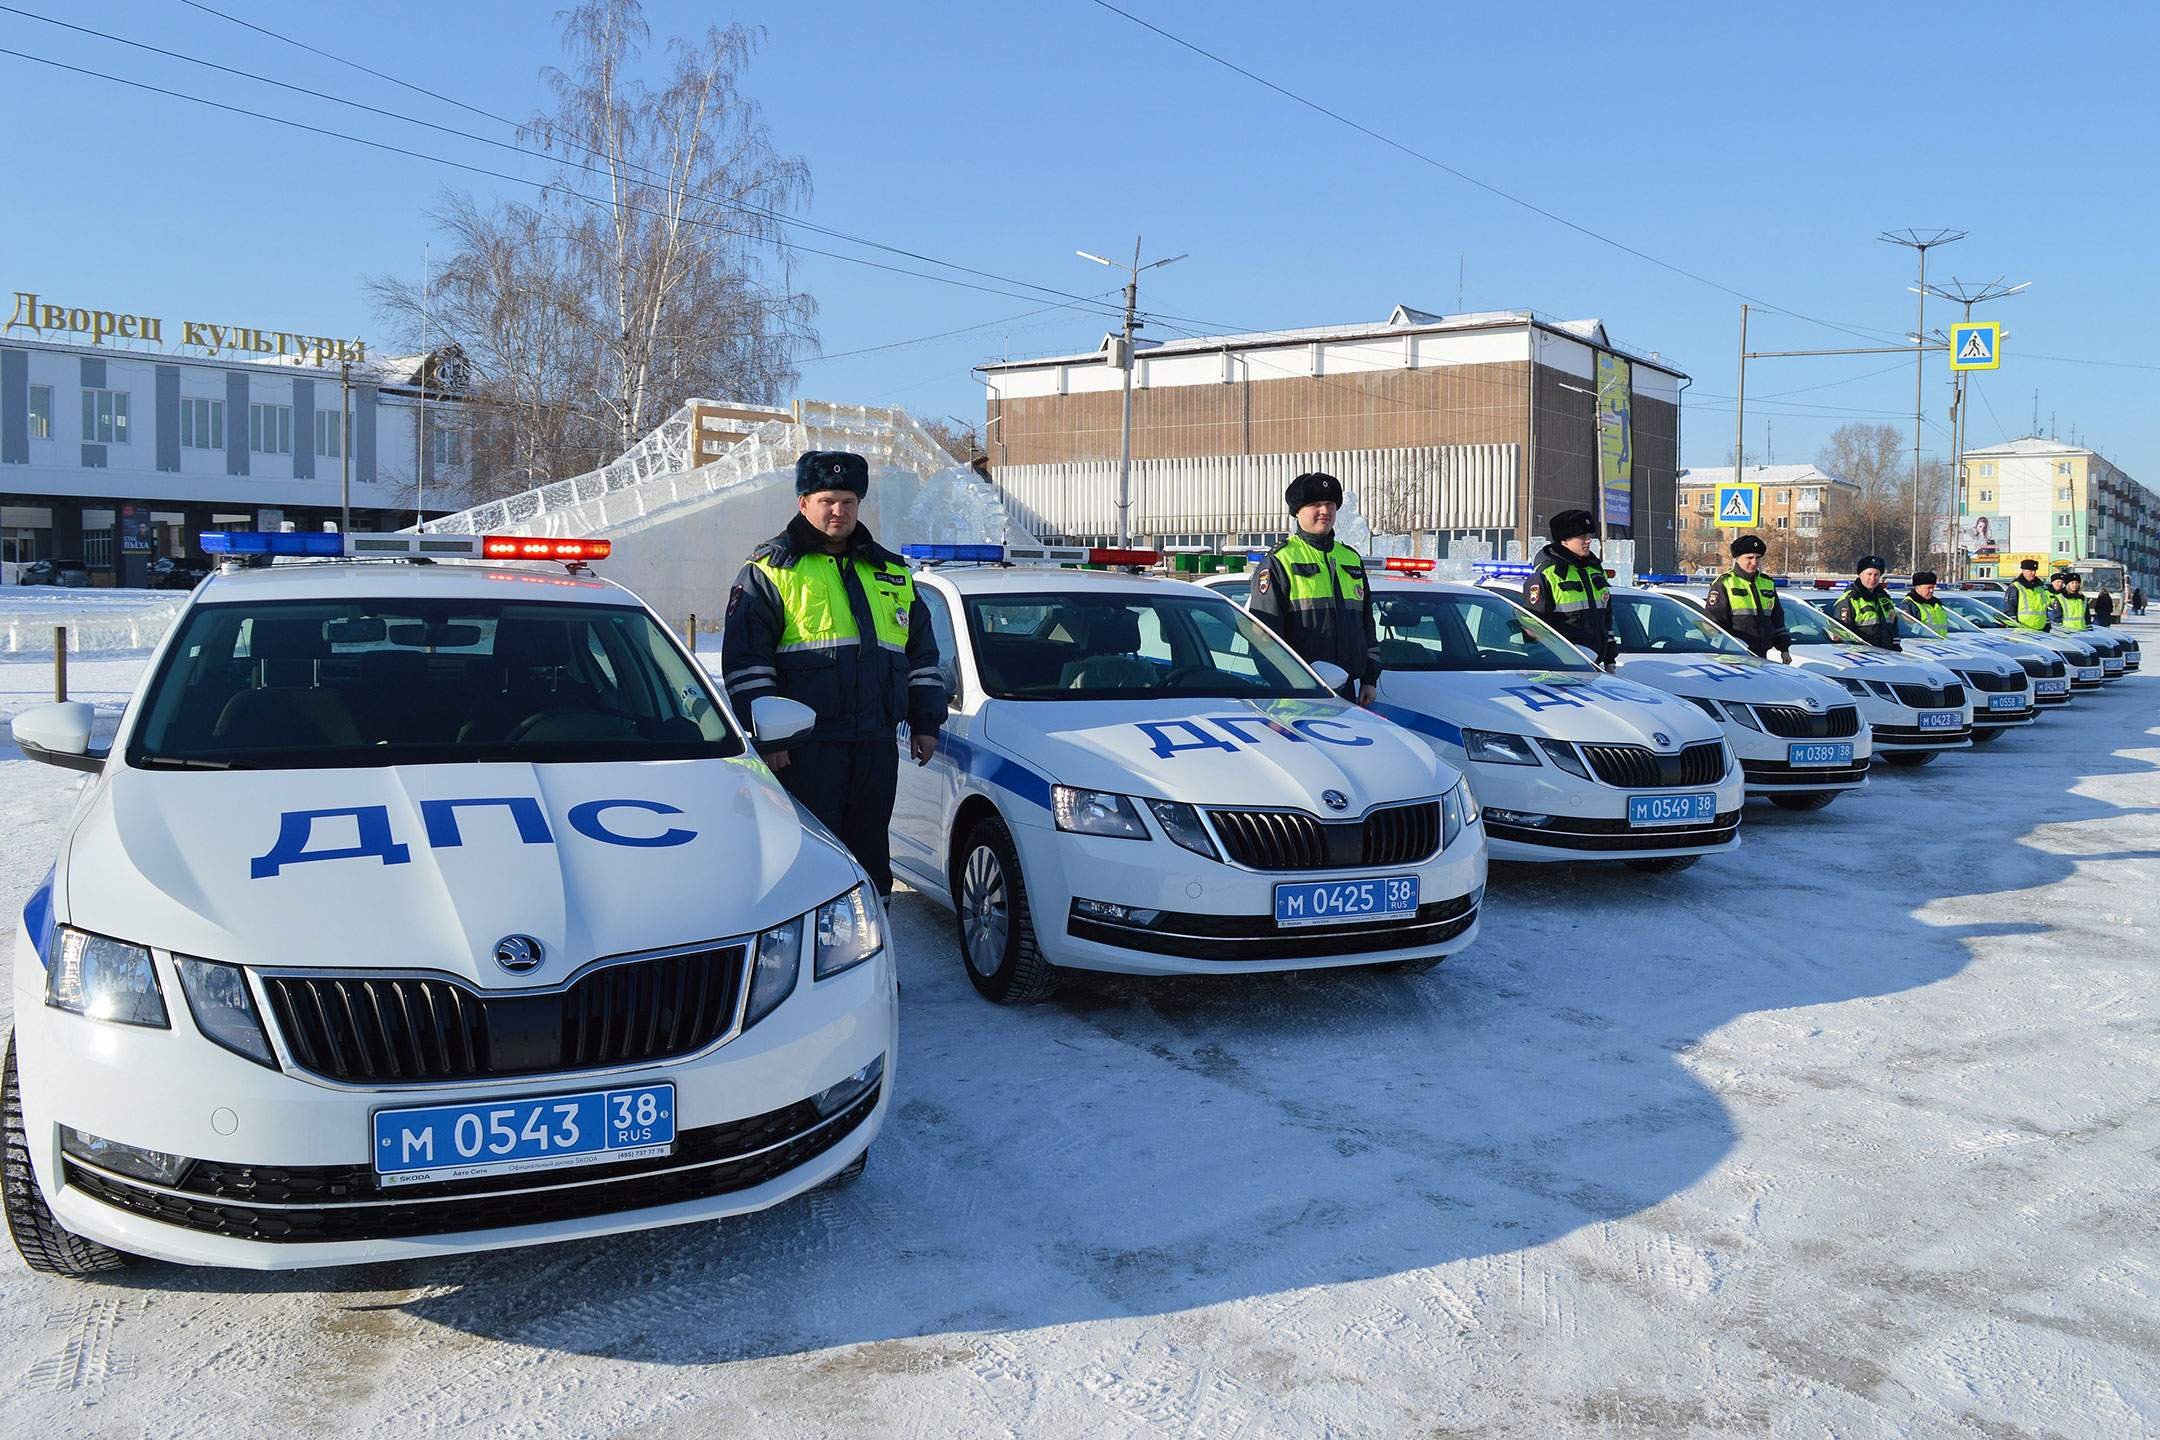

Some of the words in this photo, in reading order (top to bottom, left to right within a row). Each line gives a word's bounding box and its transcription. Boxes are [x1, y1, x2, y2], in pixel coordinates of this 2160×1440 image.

[5, 291, 163, 345] Дворец
[182, 320, 366, 367] культуры
[1498, 683, 1664, 712] ДПС
[1923, 717, 1929, 726] М
[1931, 714, 1951, 726] 0423
[1134, 717, 1374, 759] ДПС
[1795, 750, 1804, 761] М
[1807, 746, 1834, 761] 0389
[1839, 745, 1850, 756] 38
[1637, 804, 1647, 819] М
[1652, 798, 1689, 818] 0549
[1697, 796, 1711, 811] 38
[251, 797, 698, 880] ДПС
[1287, 895, 1304, 916] М
[1313, 884, 1374, 914] 0425
[1388, 880, 1411, 901] 38
[1391, 900, 1408, 910] RUS
[401, 1126, 433, 1163] М
[454, 1103, 580, 1159] 0543
[612, 1093, 657, 1130] 38
[618, 1127, 652, 1143] RUS
[617, 1150, 634, 1159] (495)
[452, 1169, 470, 1177] Авто
[470, 1167, 488, 1175] Сити
[508, 1160, 554, 1172] Официальный
[554, 1157, 574, 1167] дилер
[399, 1173, 431, 1182] ŠKODA
